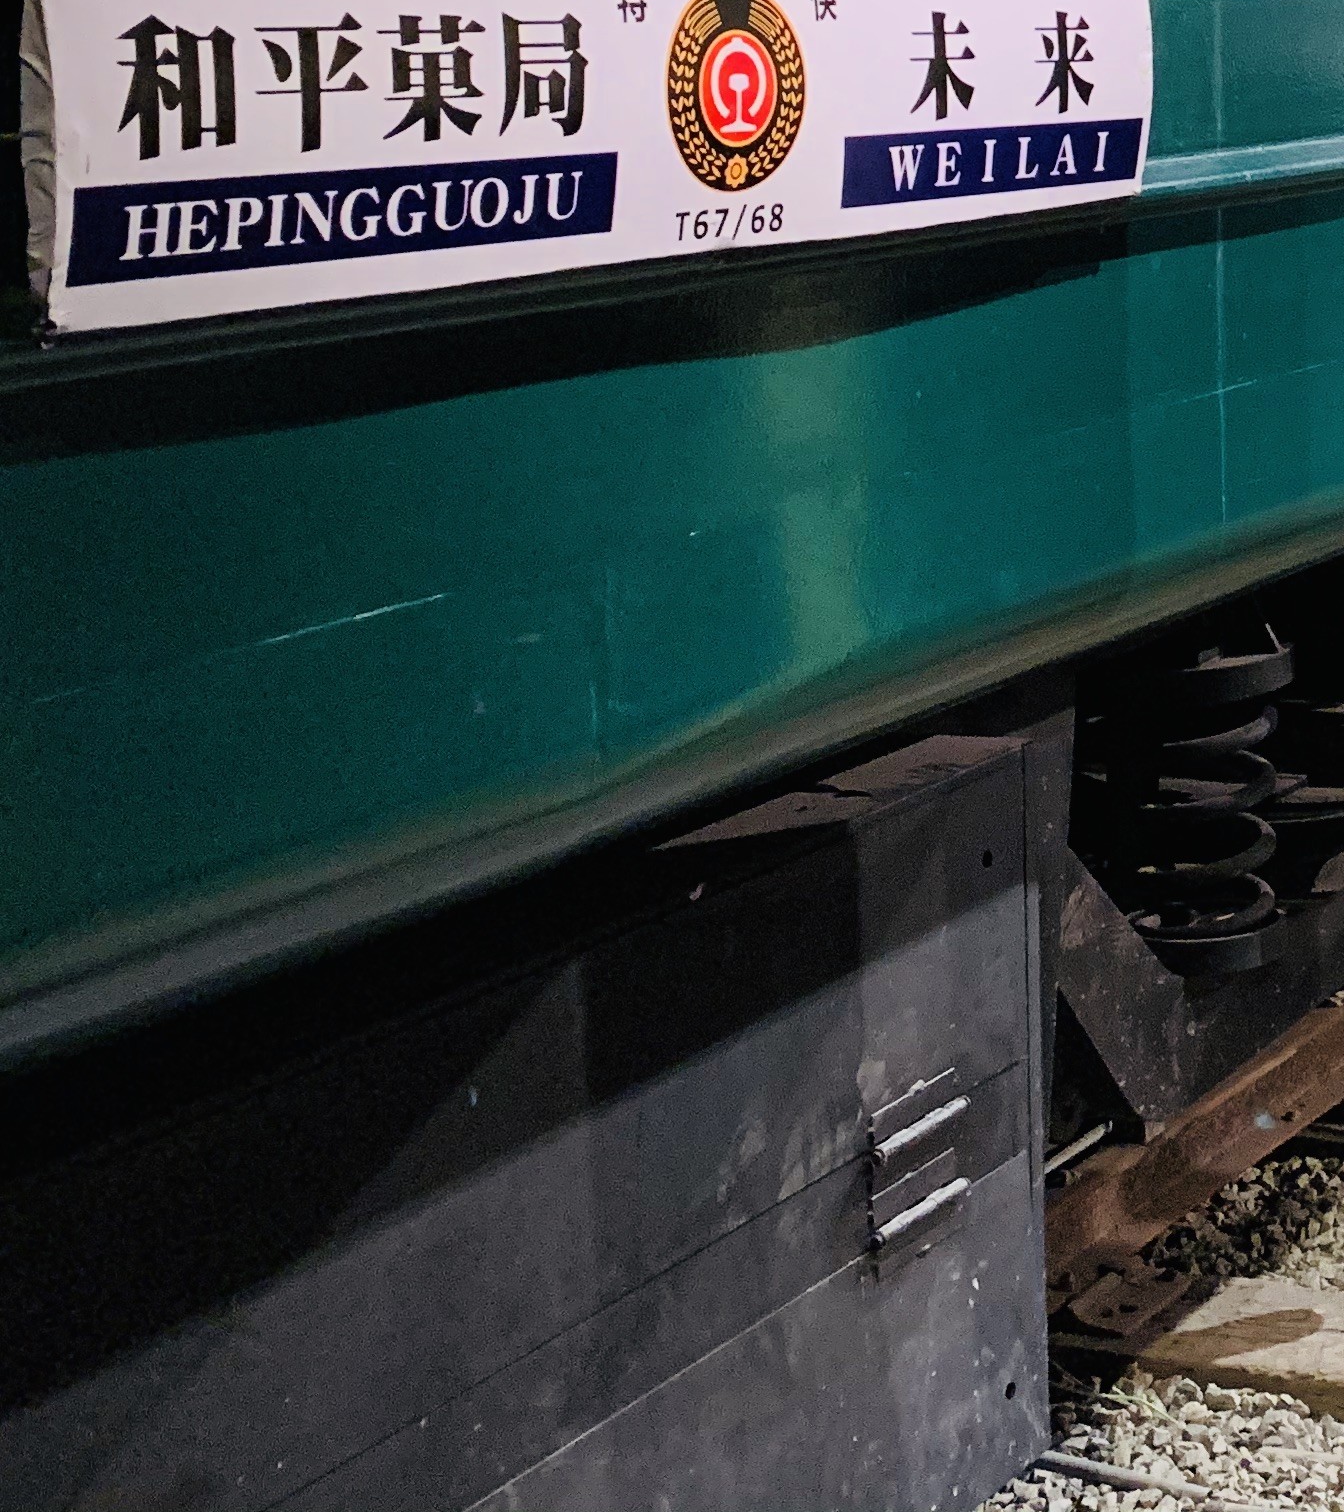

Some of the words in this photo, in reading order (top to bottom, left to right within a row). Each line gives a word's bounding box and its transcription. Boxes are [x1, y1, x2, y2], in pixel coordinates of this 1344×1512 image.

[116, 12, 590, 161] 和平菓局
[911, 10, 1095, 121] 未来
[121, 170, 585, 262] HEPINGGUOJU
[887, 129, 1112, 191] WEILAI
[675, 202, 785, 242] T67/68
